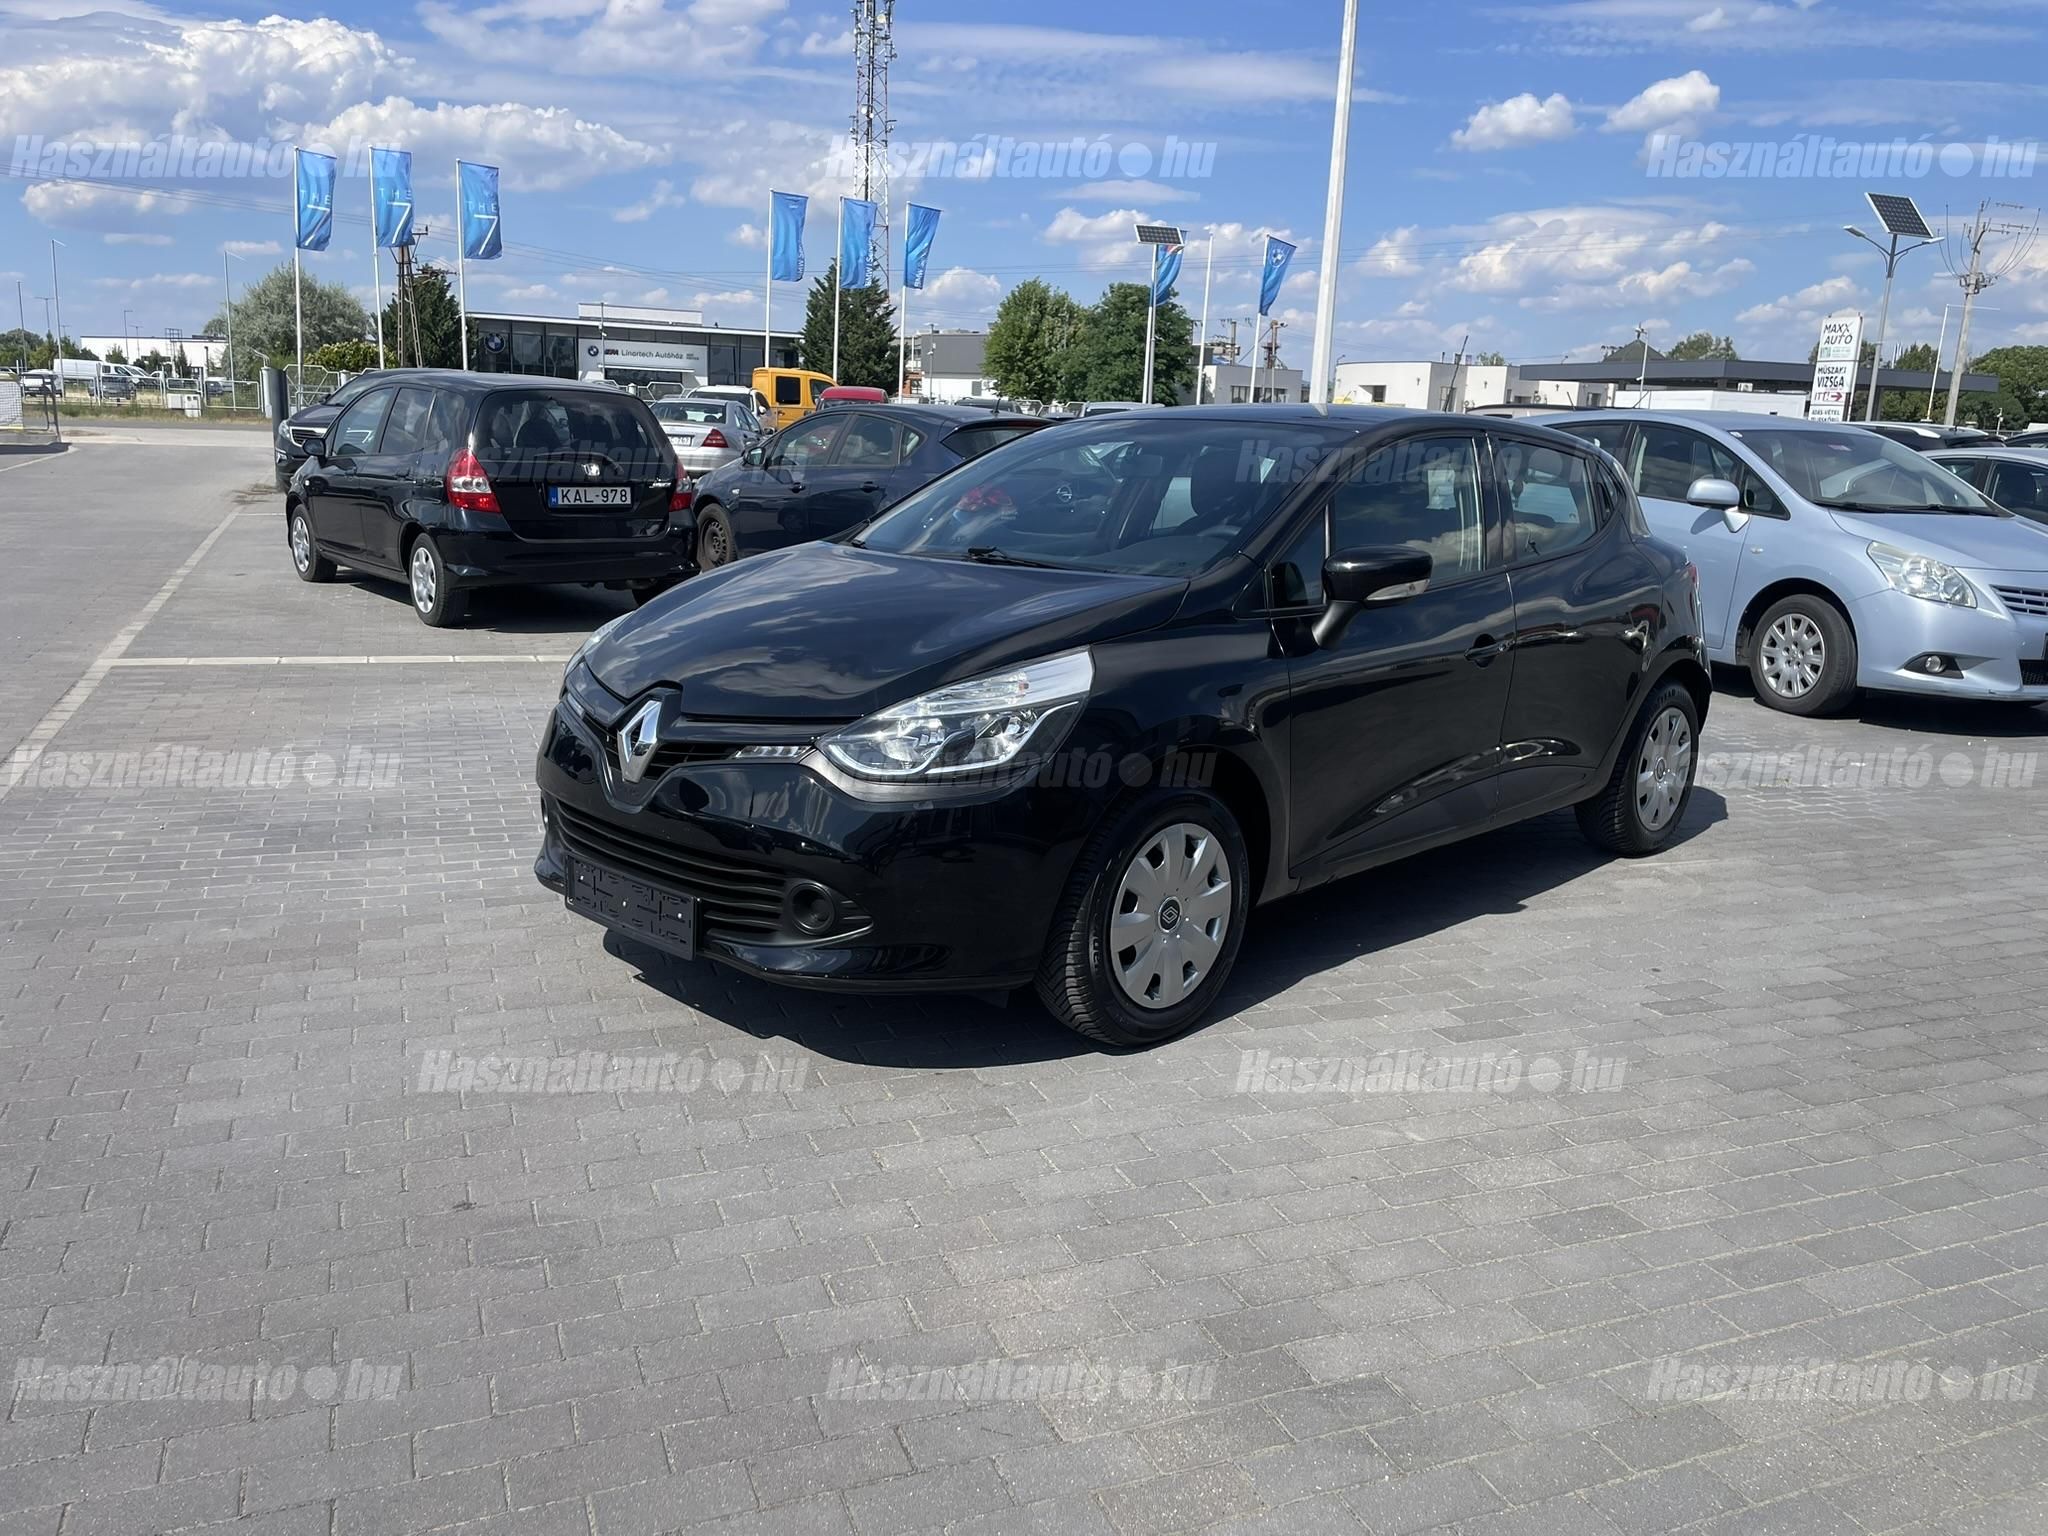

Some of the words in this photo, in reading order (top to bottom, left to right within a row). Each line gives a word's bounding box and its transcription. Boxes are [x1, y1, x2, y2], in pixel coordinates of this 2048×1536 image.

[300, 189, 331, 205] THE
[307, 203, 330, 246] 7
[387, 201, 411, 244] 7
[474, 214, 498, 255] 7
[1823, 334, 1853, 345] AUTO
[1817, 375, 1845, 388] VIZSGA
[561, 488, 627, 503] KAL-978
